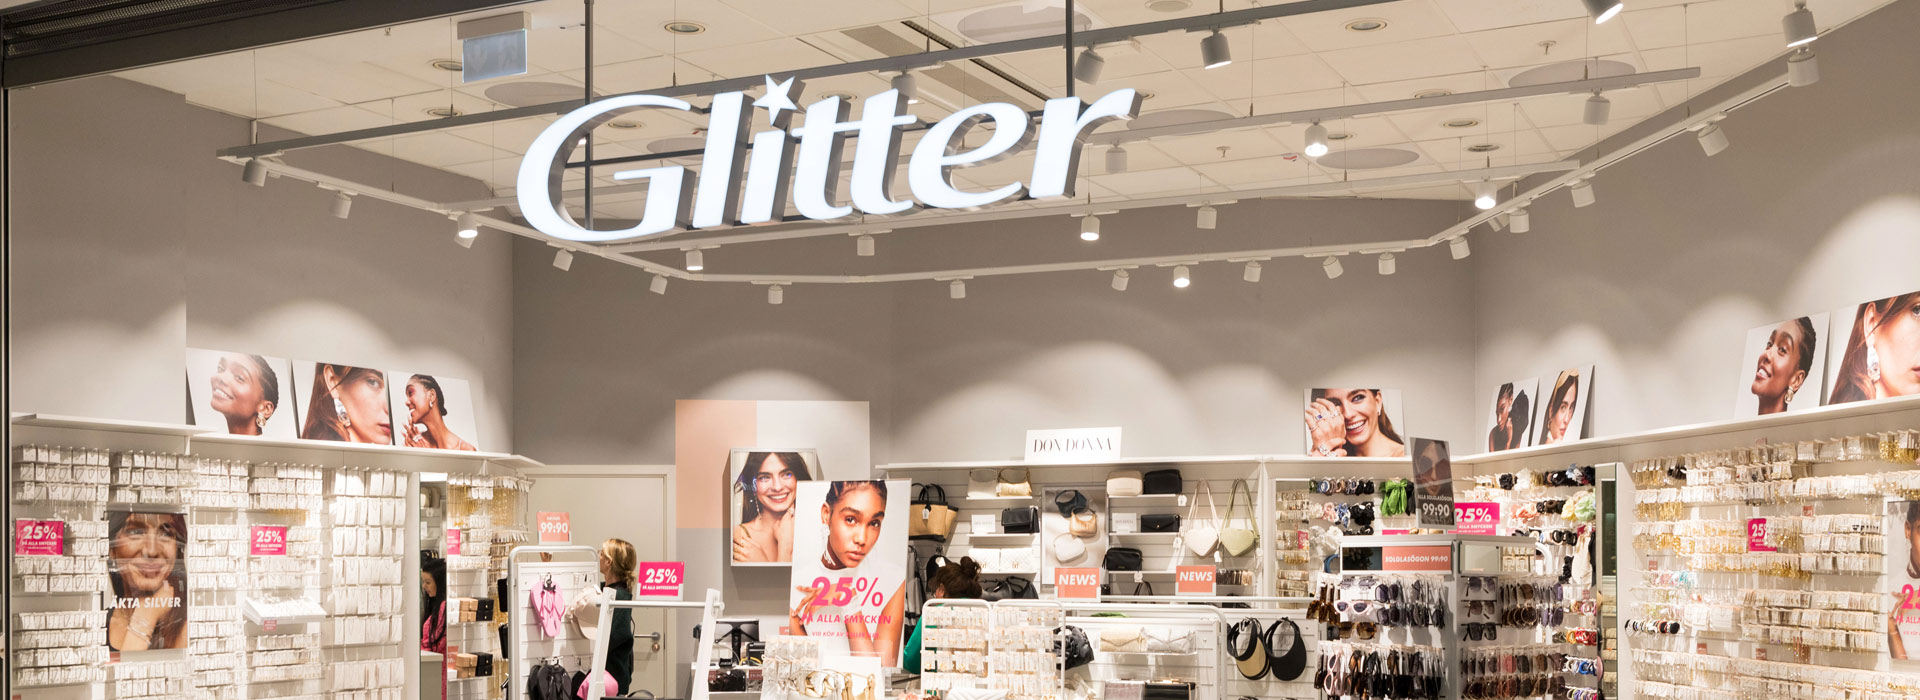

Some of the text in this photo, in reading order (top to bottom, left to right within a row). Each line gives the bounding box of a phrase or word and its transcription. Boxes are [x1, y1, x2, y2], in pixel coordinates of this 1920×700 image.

[516, 73, 1139, 242] Glitter
[1033, 437, 1112, 453] DON DONNA
[1422, 503, 1450, 517] 99:90
[1455, 508, 1492, 522] 25%
[23, 525, 57, 540] 25%
[540, 522, 568, 534] 99:90
[256, 530, 282, 543] 25%
[1385, 554, 1430, 563] SOLGLASÖGON
[645, 568, 677, 583] 25%
[1058, 574, 1097, 586] NEWS
[1179, 571, 1213, 582] NEWS
[810, 576, 884, 607] 25%
[109, 595, 181, 609] ÄKTA SILVER
[817, 614, 840, 623] ALLA
[844, 614, 892, 624] SMYCKEN
